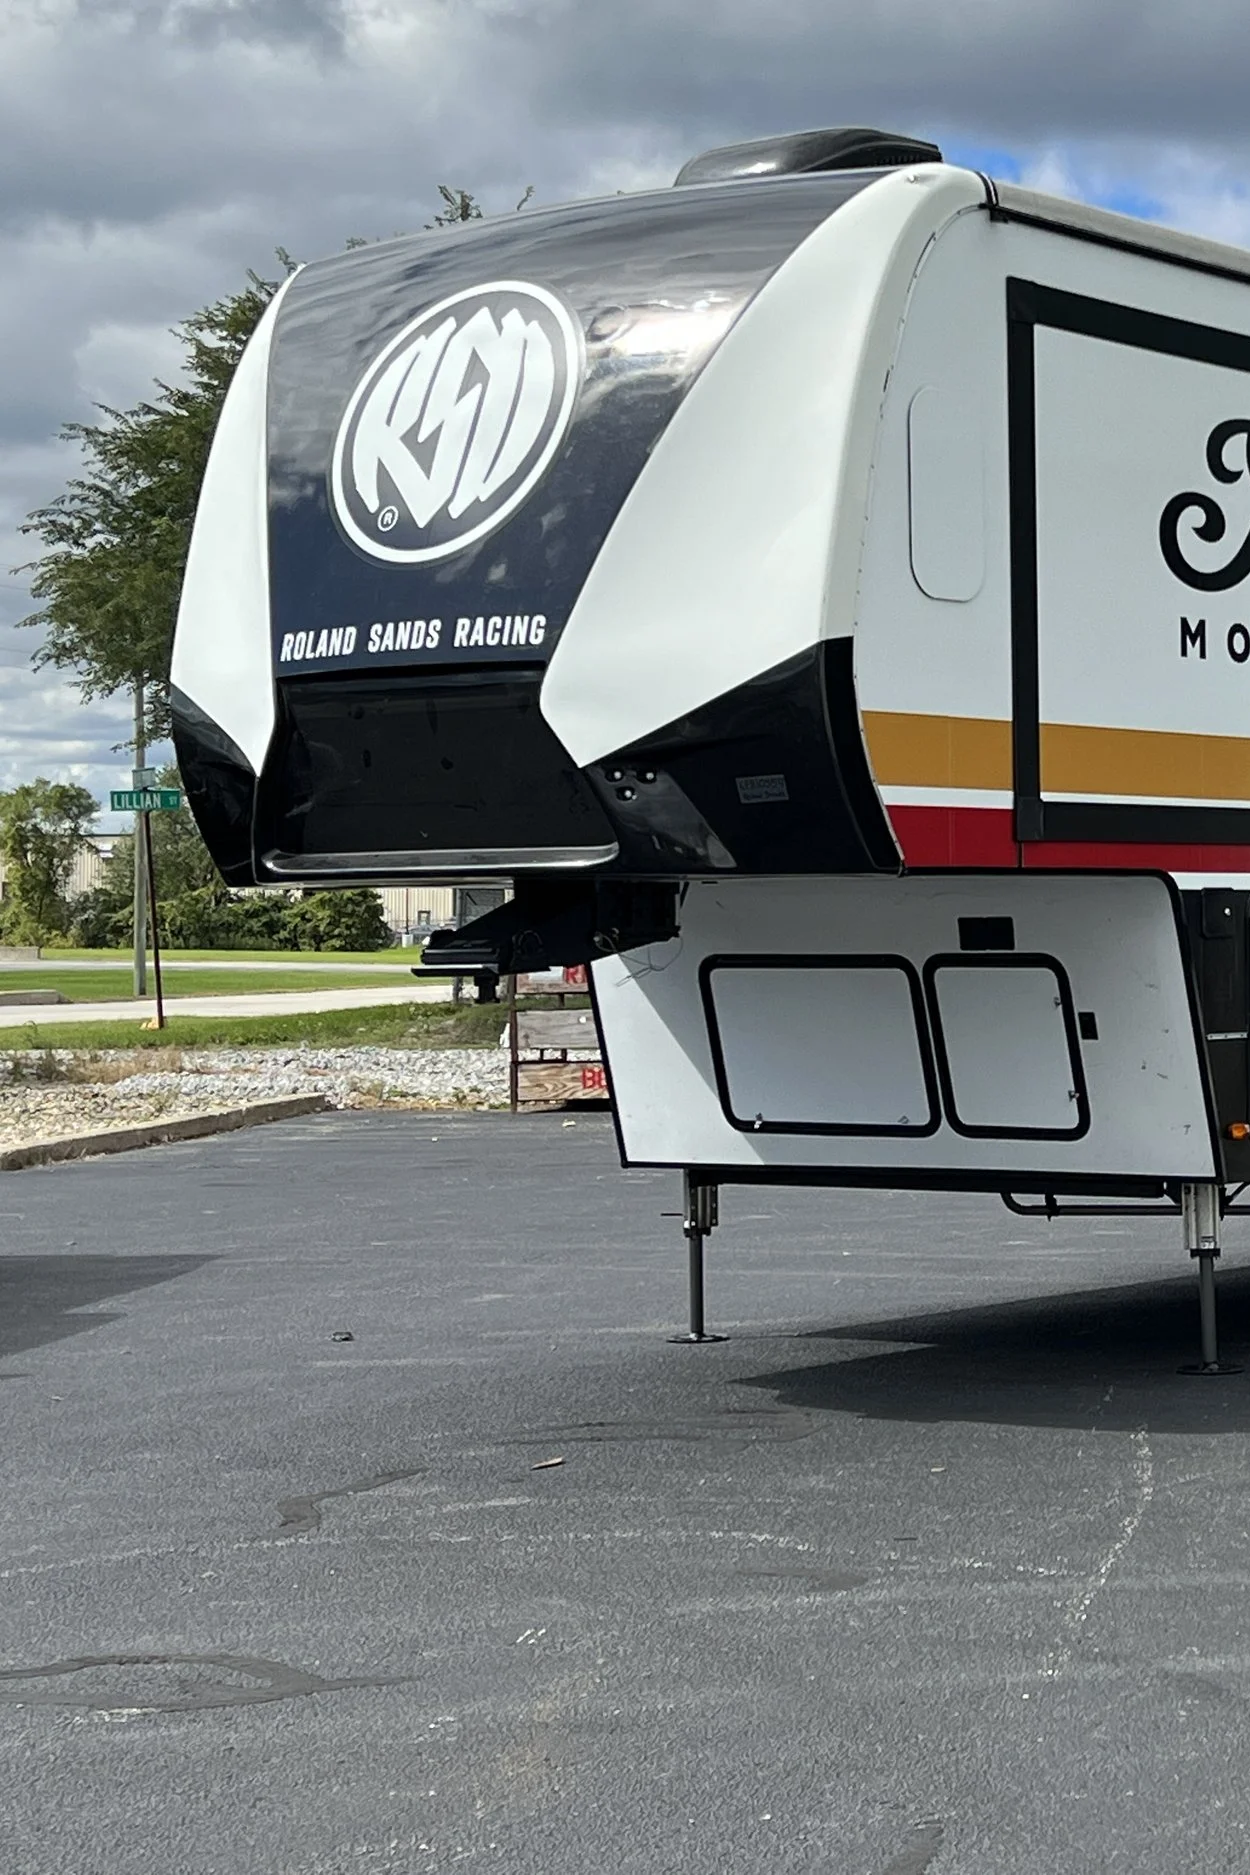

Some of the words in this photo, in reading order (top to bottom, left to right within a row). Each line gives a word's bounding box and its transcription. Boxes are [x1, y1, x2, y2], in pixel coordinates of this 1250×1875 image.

[280, 626, 357, 662] ROLAND
[367, 619, 442, 653] SANDS
[453, 614, 547, 648] RACING
[113, 793, 161, 809] LILLIAN
